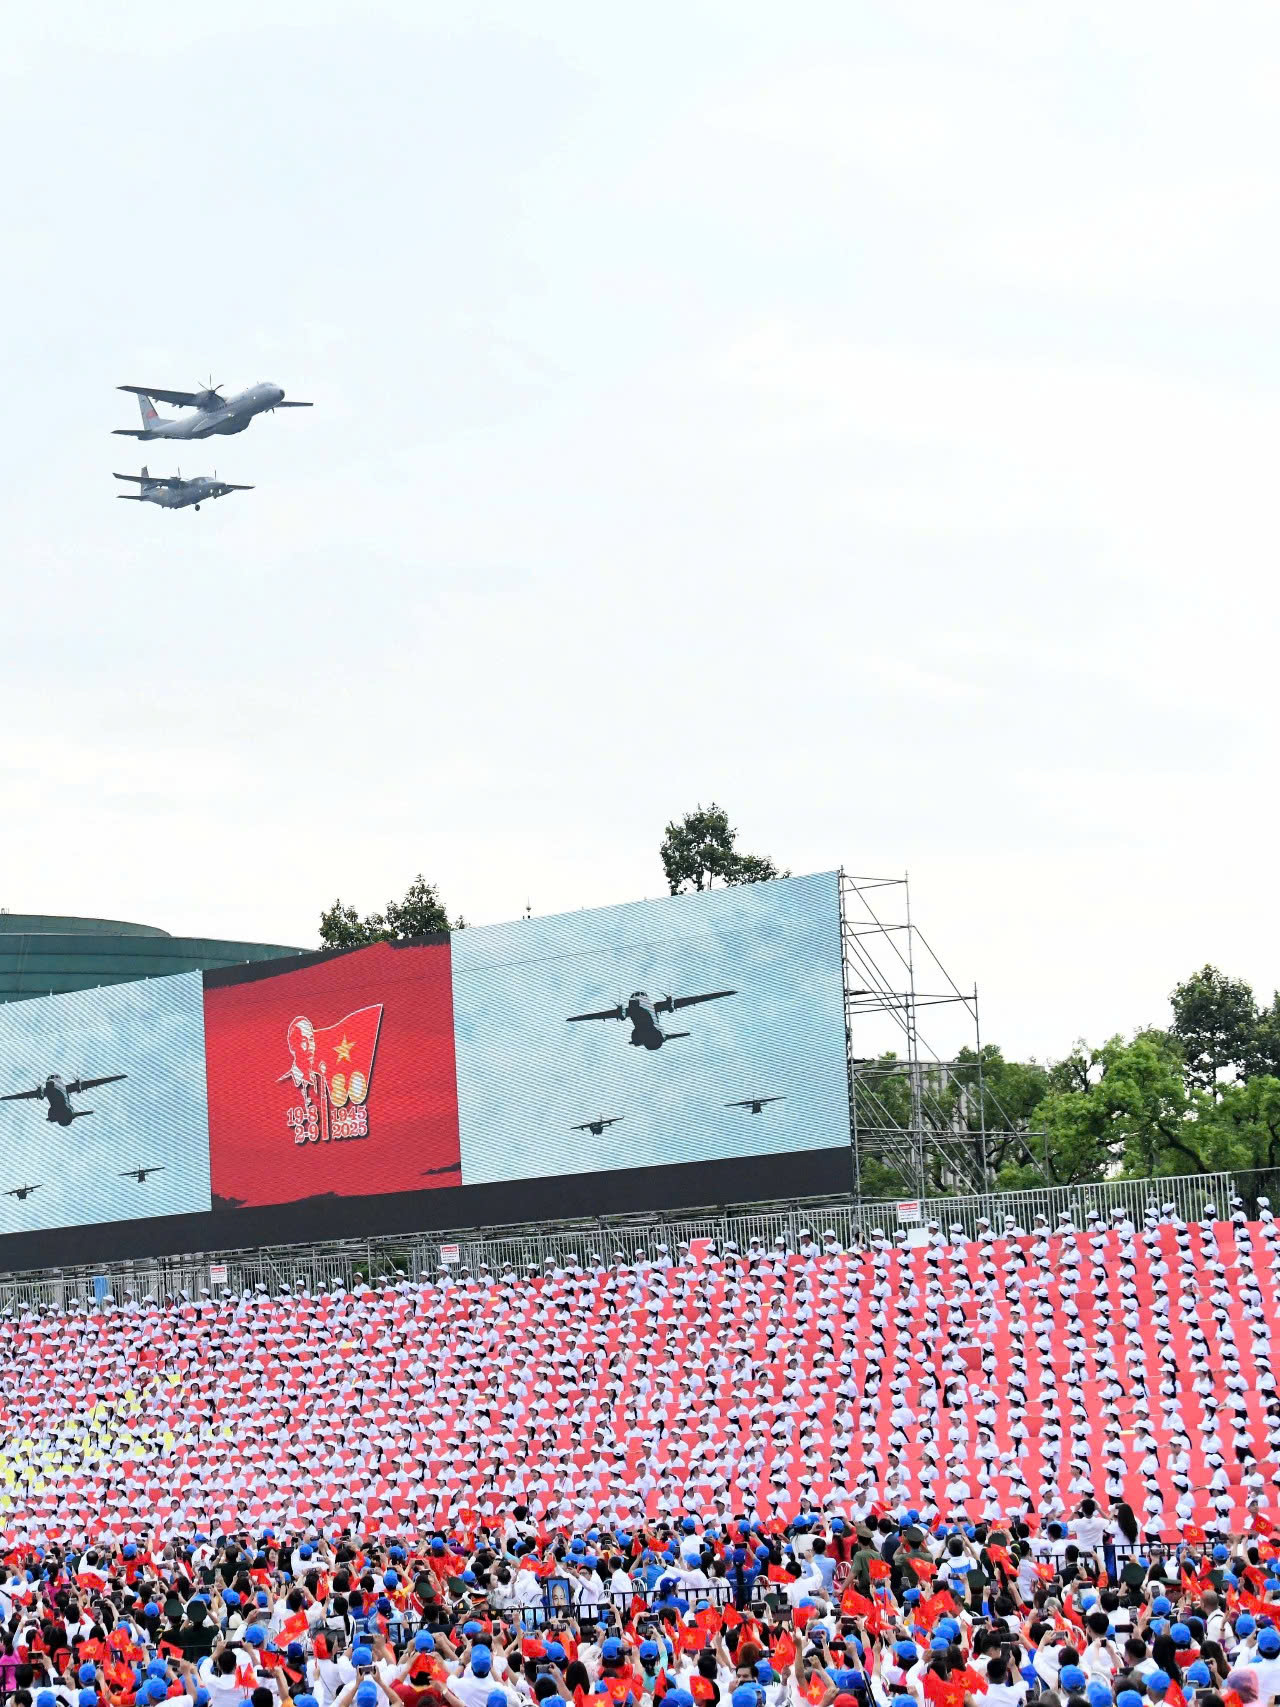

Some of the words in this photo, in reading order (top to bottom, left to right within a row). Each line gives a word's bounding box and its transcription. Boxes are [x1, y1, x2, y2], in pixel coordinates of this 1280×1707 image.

[287, 1105, 318, 1126] 19-8
[331, 1105, 367, 1123] 1945
[295, 1123, 319, 1144] 2-9
[332, 1121, 367, 1139] 2025
